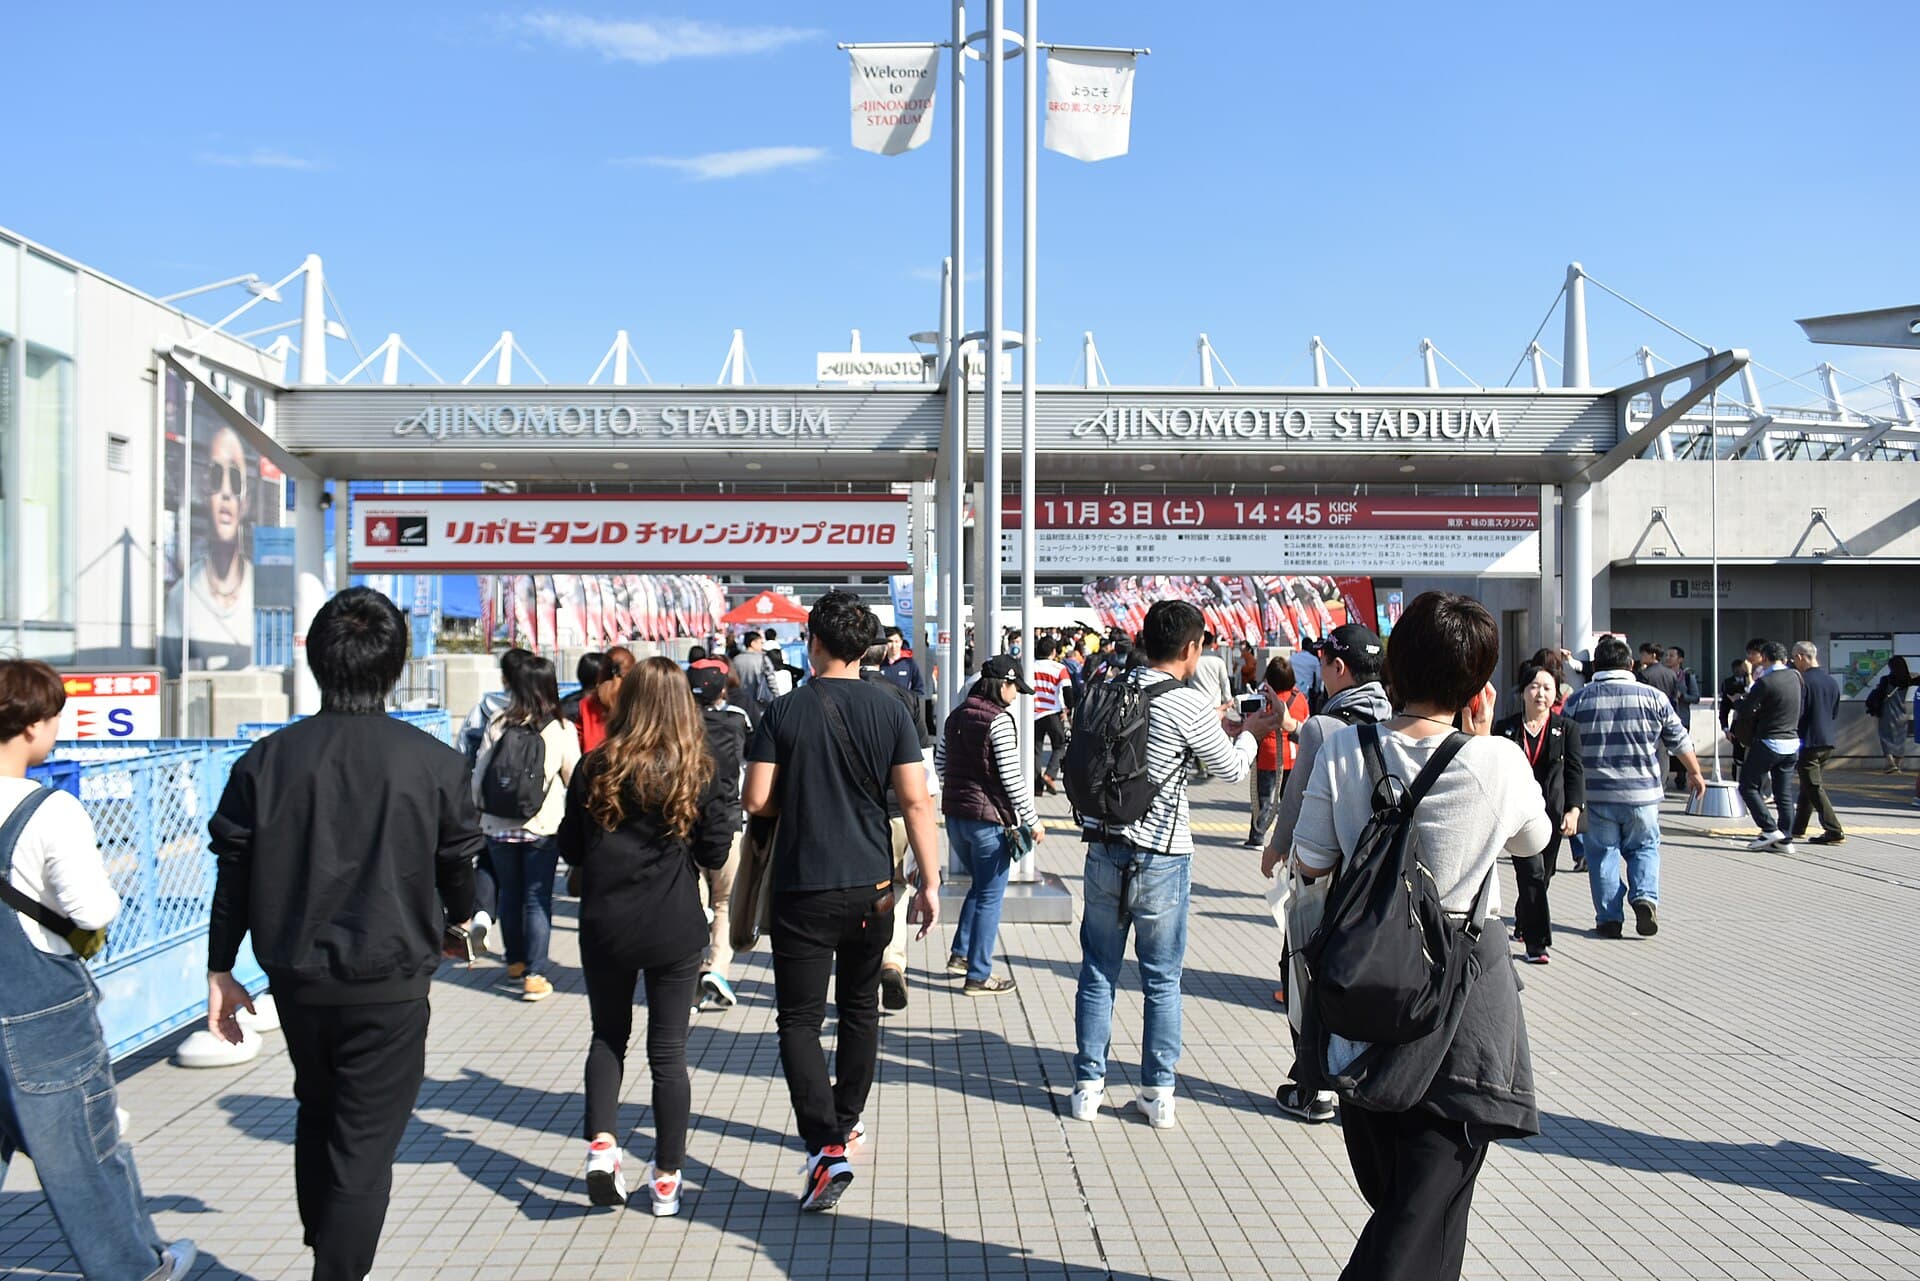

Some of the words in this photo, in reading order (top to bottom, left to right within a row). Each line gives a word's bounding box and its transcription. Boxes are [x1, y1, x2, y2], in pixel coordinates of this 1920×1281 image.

[863, 65, 928, 79] Welcome
[889, 83, 903, 94] to
[1071, 85, 1110, 98] ようこそ
[852, 99, 932, 113] AJINOMOTO
[1048, 101, 1129, 116] 味の素スタジアム
[866, 115, 923, 126] STADIUM
[393, 404, 638, 440] AJINOMOTO
[661, 405, 833, 437] STADIUM
[1073, 407, 1312, 441] AJINOMOTO
[1333, 408, 1502, 438] STADIUM
[1234, 502, 1321, 525] 14:45
[1328, 501, 1358, 513] KICK
[1328, 513, 1352, 525] OFF
[1447, 518, 1535, 528] 東京・味の素スタジアム
[445, 517, 628, 545] リポビタンD
[635, 521, 896, 545] チャレンジカップ2018
